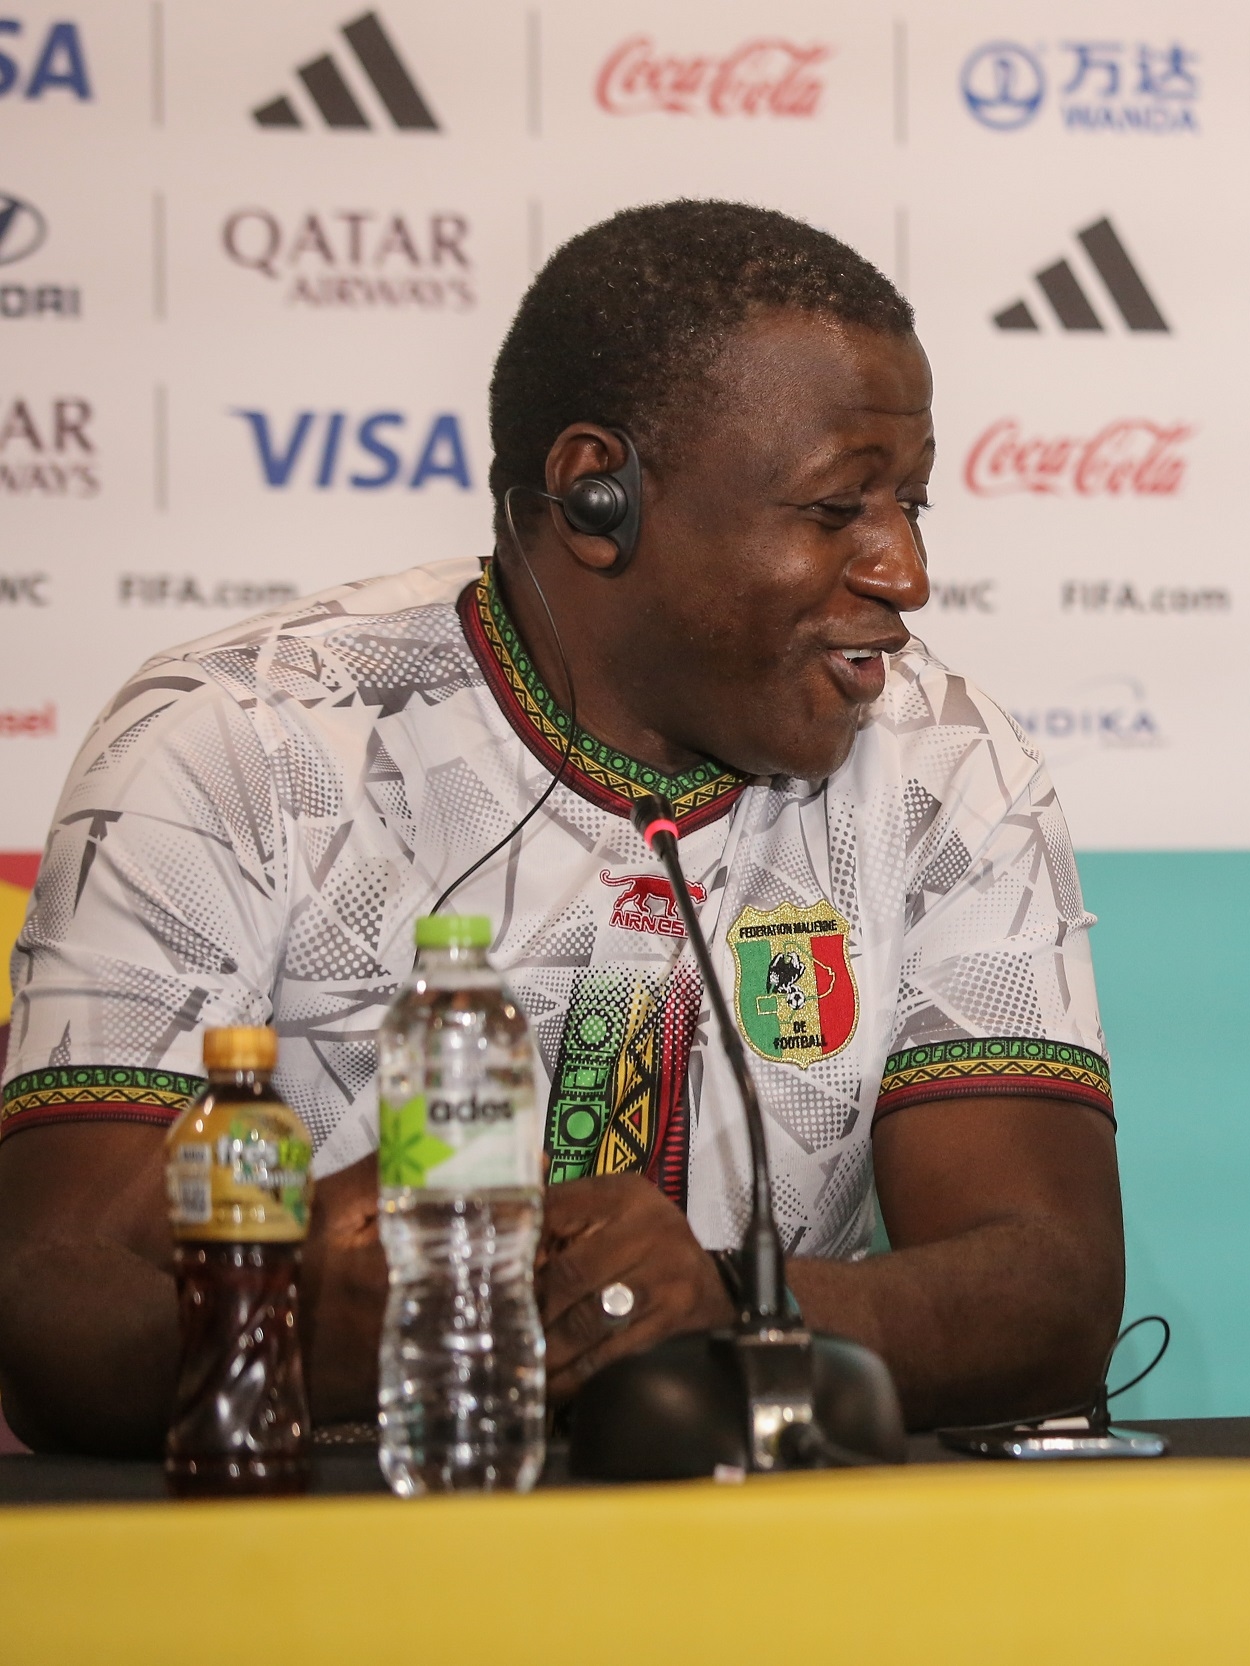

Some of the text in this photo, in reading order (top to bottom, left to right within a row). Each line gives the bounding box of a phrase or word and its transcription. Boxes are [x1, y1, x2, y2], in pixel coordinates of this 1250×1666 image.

[1062, 40, 1200, 99] 万达
[1062, 107, 1200, 133] WANDA
[220, 207, 474, 277] QATAR
[288, 276, 477, 311] AIRWAYS
[234, 411, 473, 491] VISA
[1061, 578, 1233, 614] FIFA.com
[609, 908, 689, 939] AIRNES
[740, 919, 838, 939] FEDERATION MALIENNE
[772, 1034, 827, 1050] FOOTBALL
[793, 1020, 807, 1035] DE
